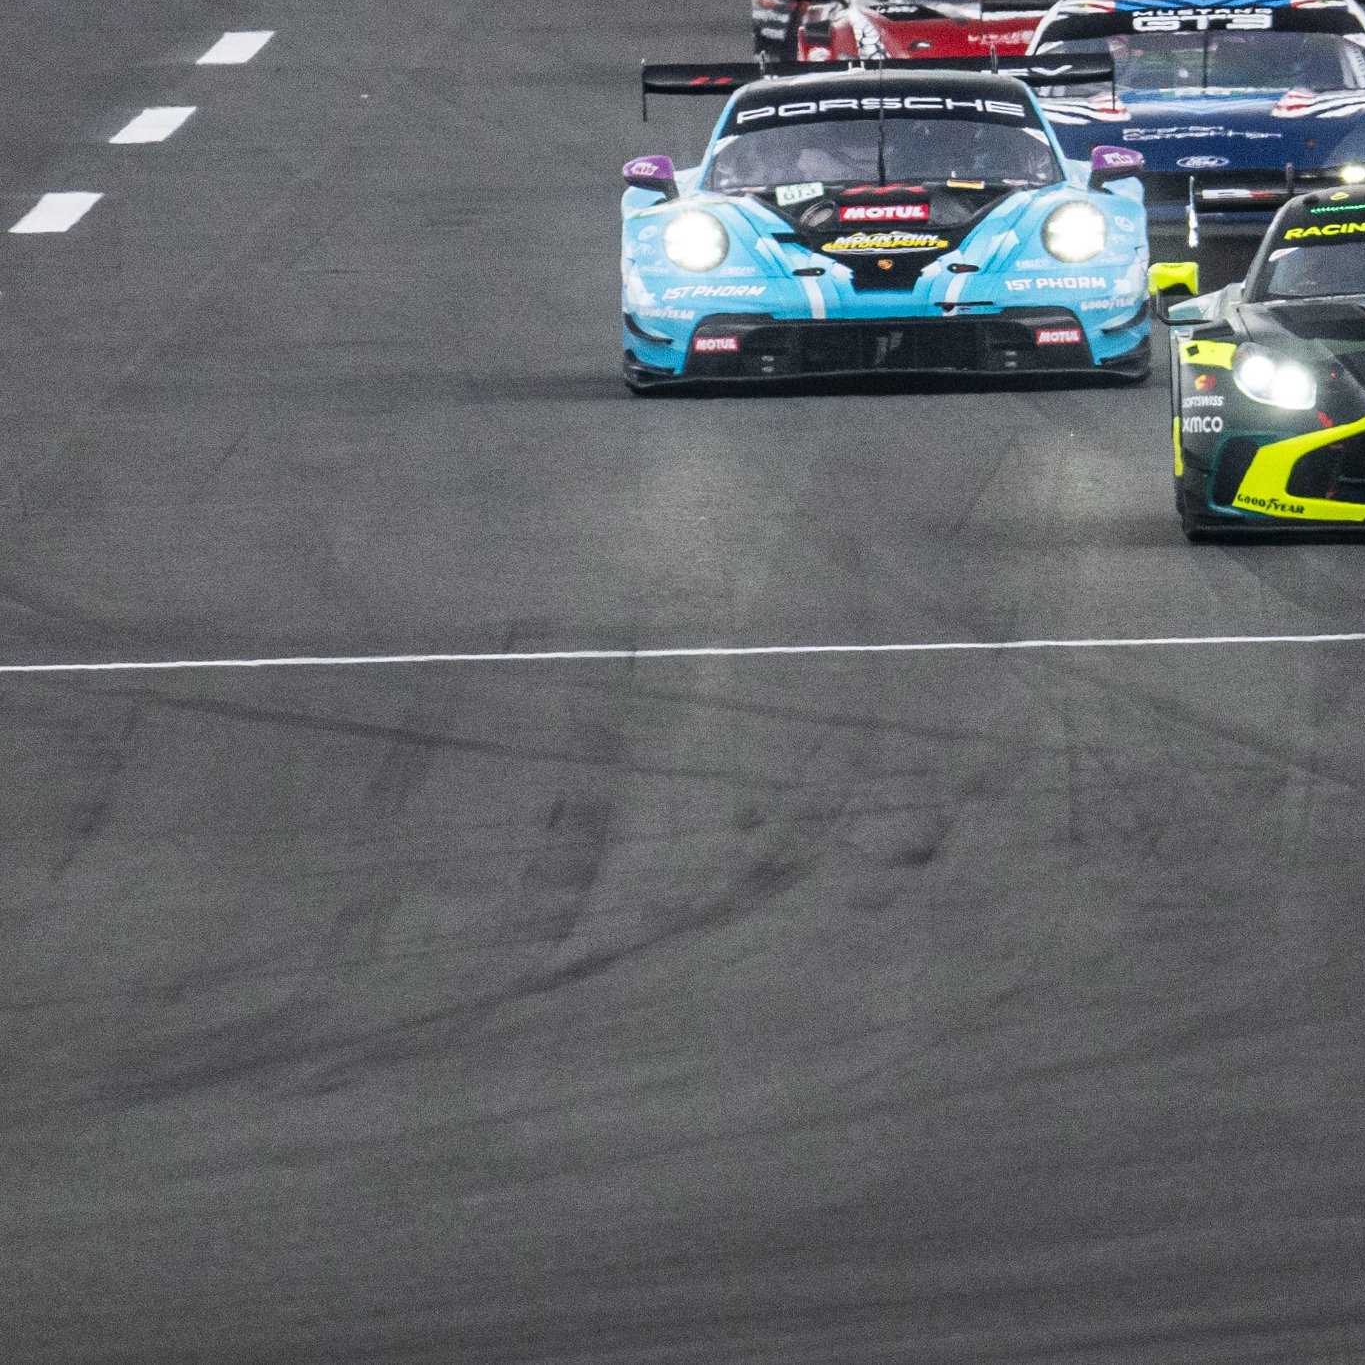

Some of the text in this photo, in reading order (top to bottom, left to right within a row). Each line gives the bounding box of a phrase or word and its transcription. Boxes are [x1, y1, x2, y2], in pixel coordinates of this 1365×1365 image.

[1132, 8, 1273, 17] MUSTANG
[1132, 15, 1273, 32] GT3
[736, 96, 1026, 124] PORSCHE
[843, 206, 926, 219] MOTUL
[821, 240, 949, 251] MOTORSPORTS
[834, 234, 940, 244] MOUNTAIN
[1036, 276, 1107, 289] PHORM
[692, 285, 767, 298] PHORM
[1038, 331, 1080, 343] MOTUL
[696, 338, 738, 351] MOTUL
[1237, 493, 1305, 515] GOODYEAR
